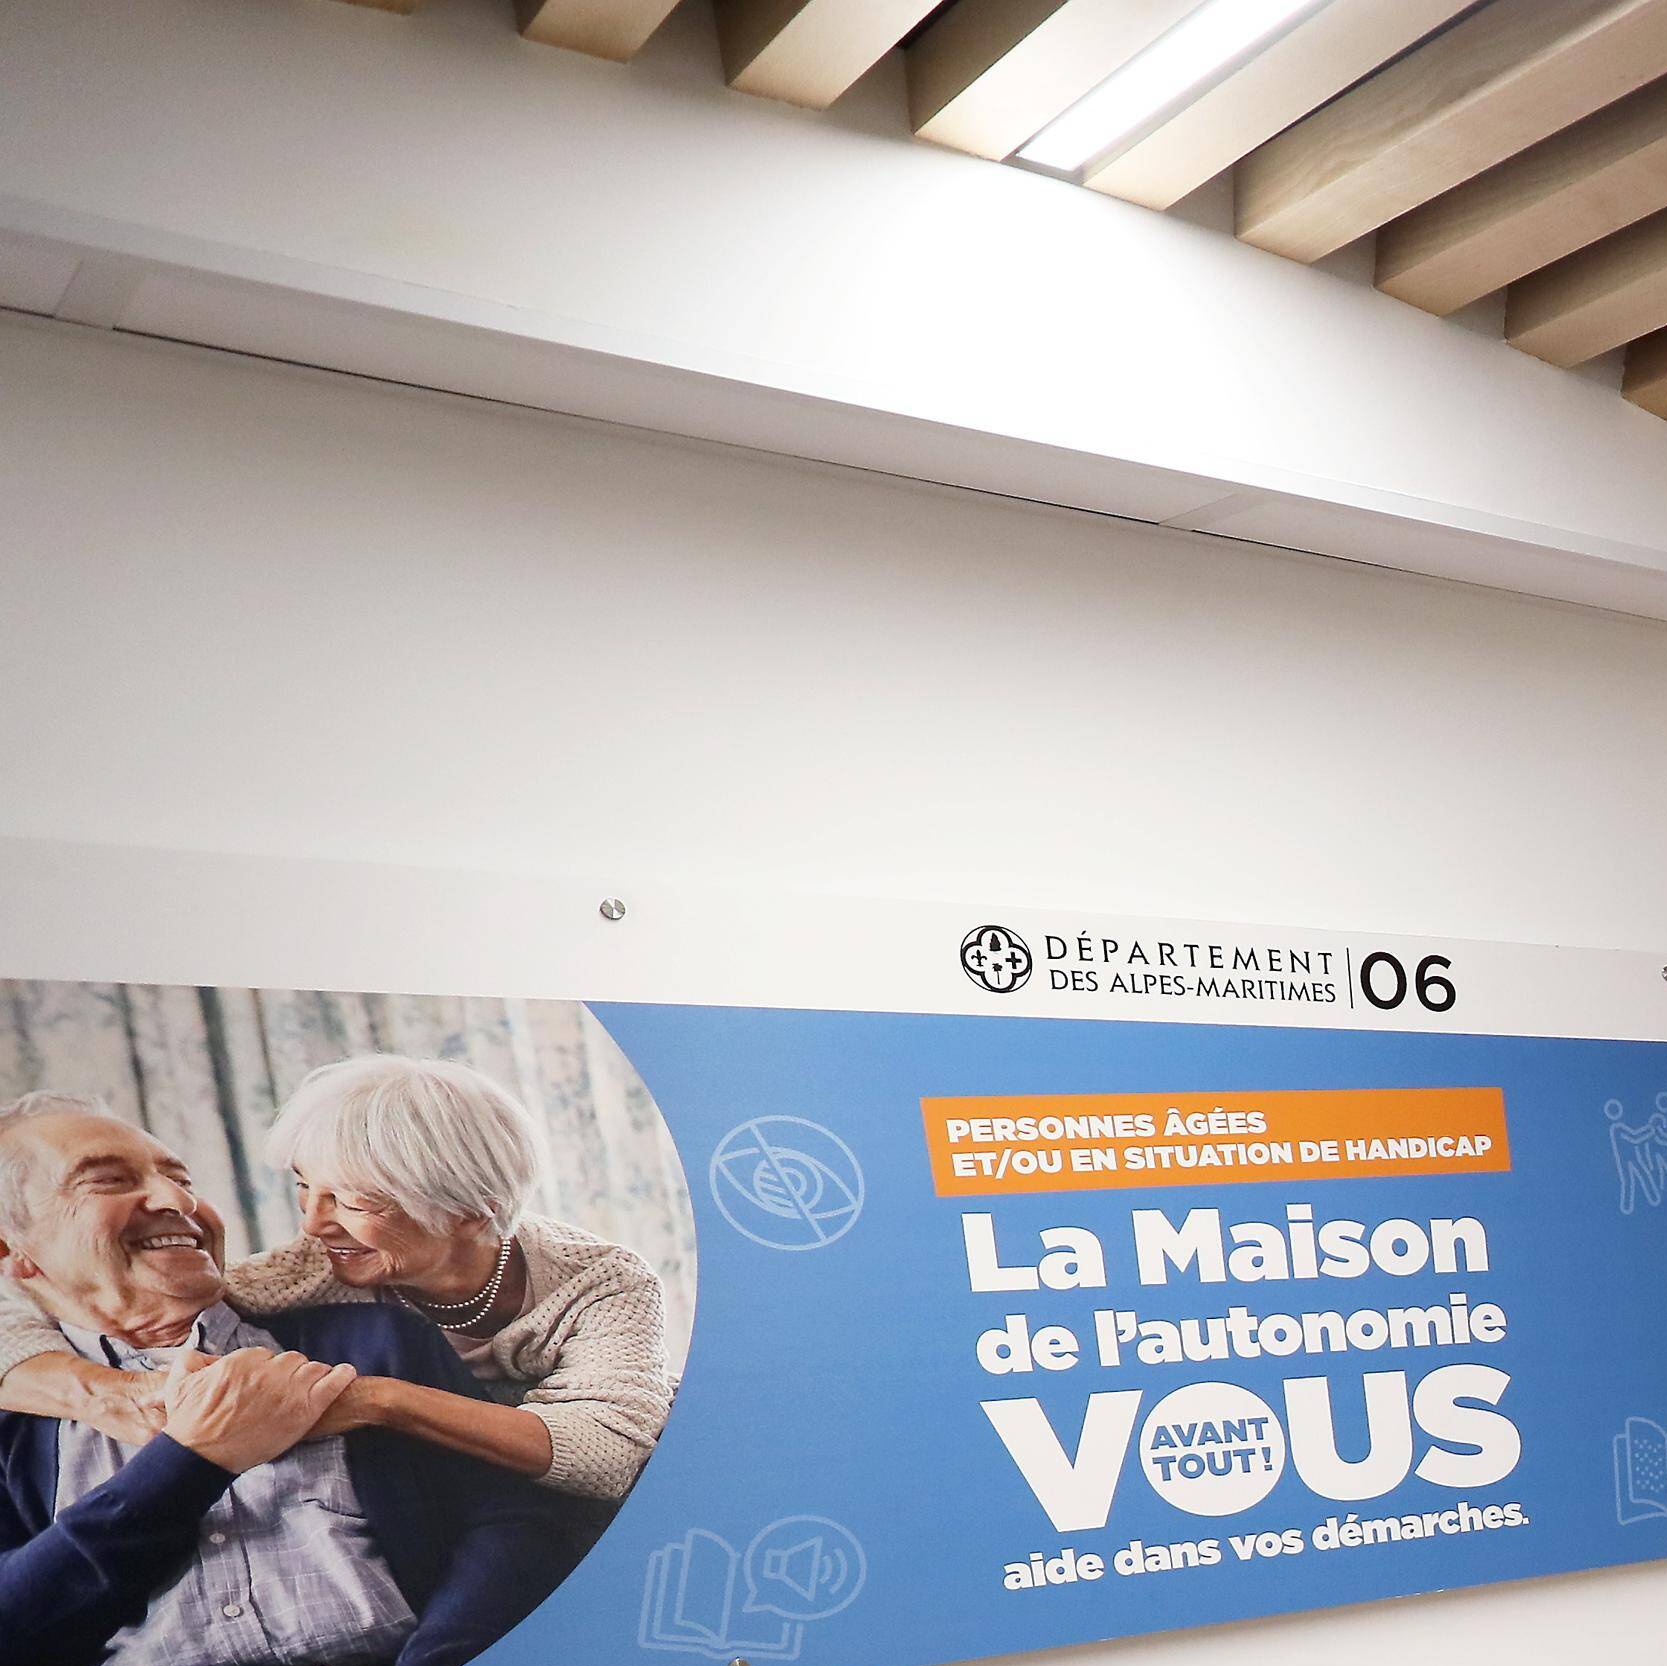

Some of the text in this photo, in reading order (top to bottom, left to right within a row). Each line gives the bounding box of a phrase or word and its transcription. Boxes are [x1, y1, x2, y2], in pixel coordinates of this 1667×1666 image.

[1045, 930, 1457, 1013] DÉPARTEMENT 06
[1050, 969, 1336, 1003] DES ALPES-MARITIMES
[946, 1107, 1268, 1143] PERSONNES ÂGÉES
[952, 1135, 1492, 1179] ET/OU EN SITUATION DE HANDICAP
[962, 1203, 1489, 1292] La Maison
[976, 1293, 1507, 1375] de l'autonomie
[980, 1363, 1522, 1532] VOUS
[1150, 1417, 1269, 1450] AVANT
[1003, 1501, 1530, 1591] aide dans vos démarches.
